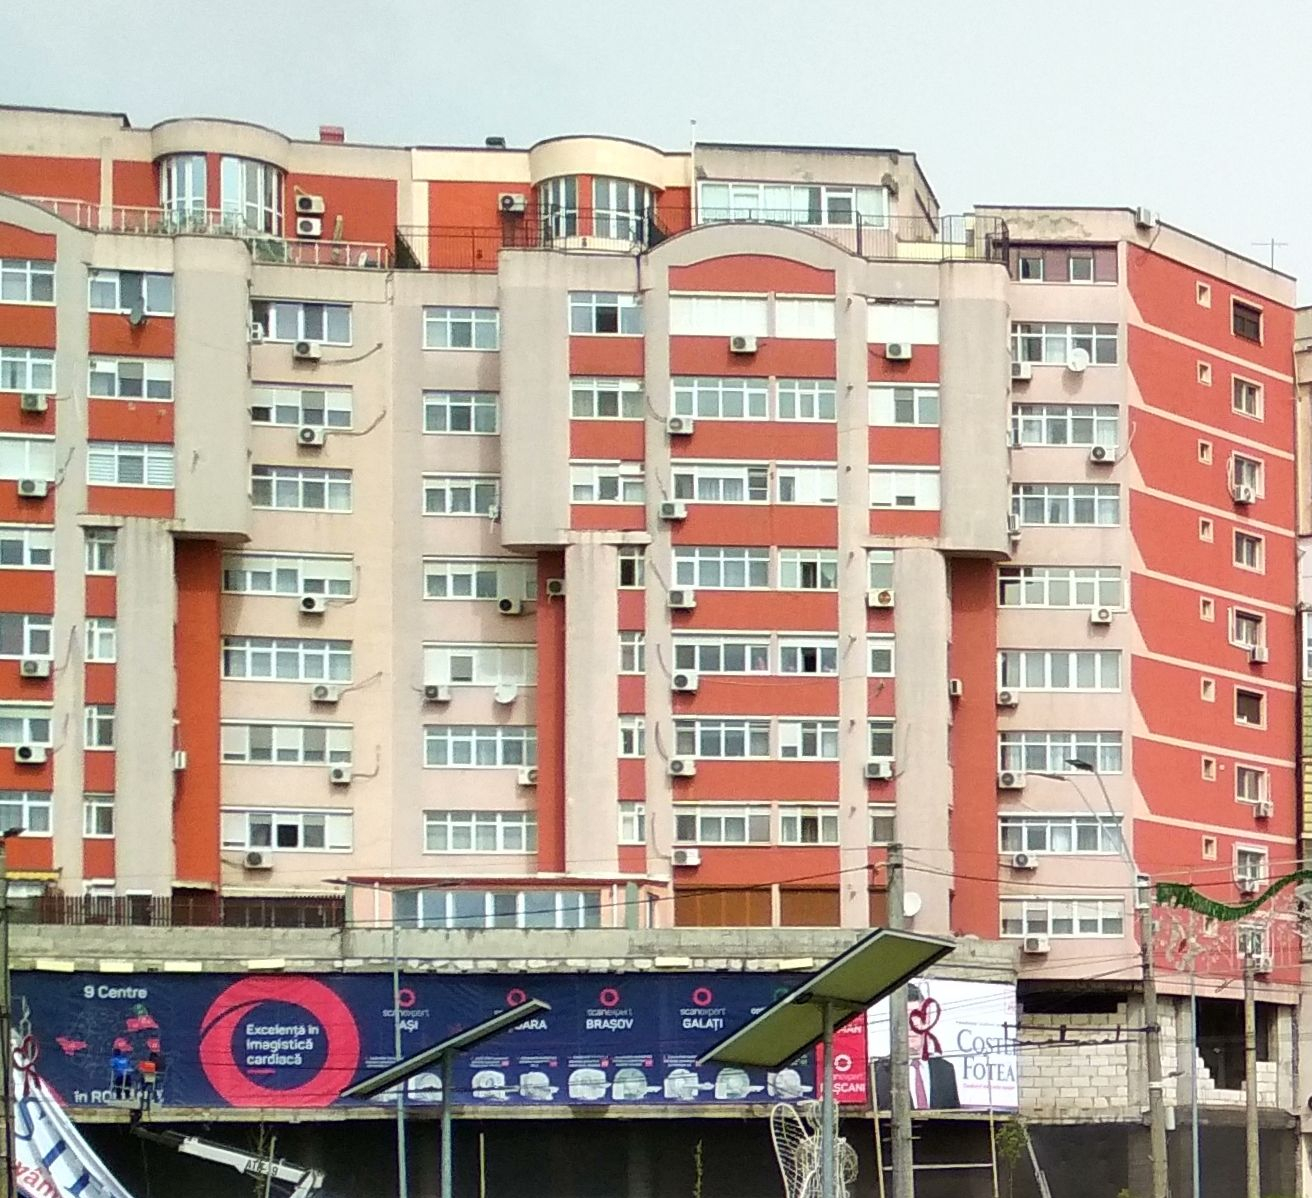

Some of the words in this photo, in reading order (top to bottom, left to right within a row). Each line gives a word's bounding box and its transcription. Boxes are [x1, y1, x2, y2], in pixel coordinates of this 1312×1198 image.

[83, 985, 95, 999] 9
[98, 985, 148, 999] Centre
[586, 1019, 634, 1032] BRAȘOV
[682, 1019, 723, 1032] GALAȚI
[246, 1053, 302, 1065] cardiacă
[963, 1055, 1015, 1082] FOTEA
